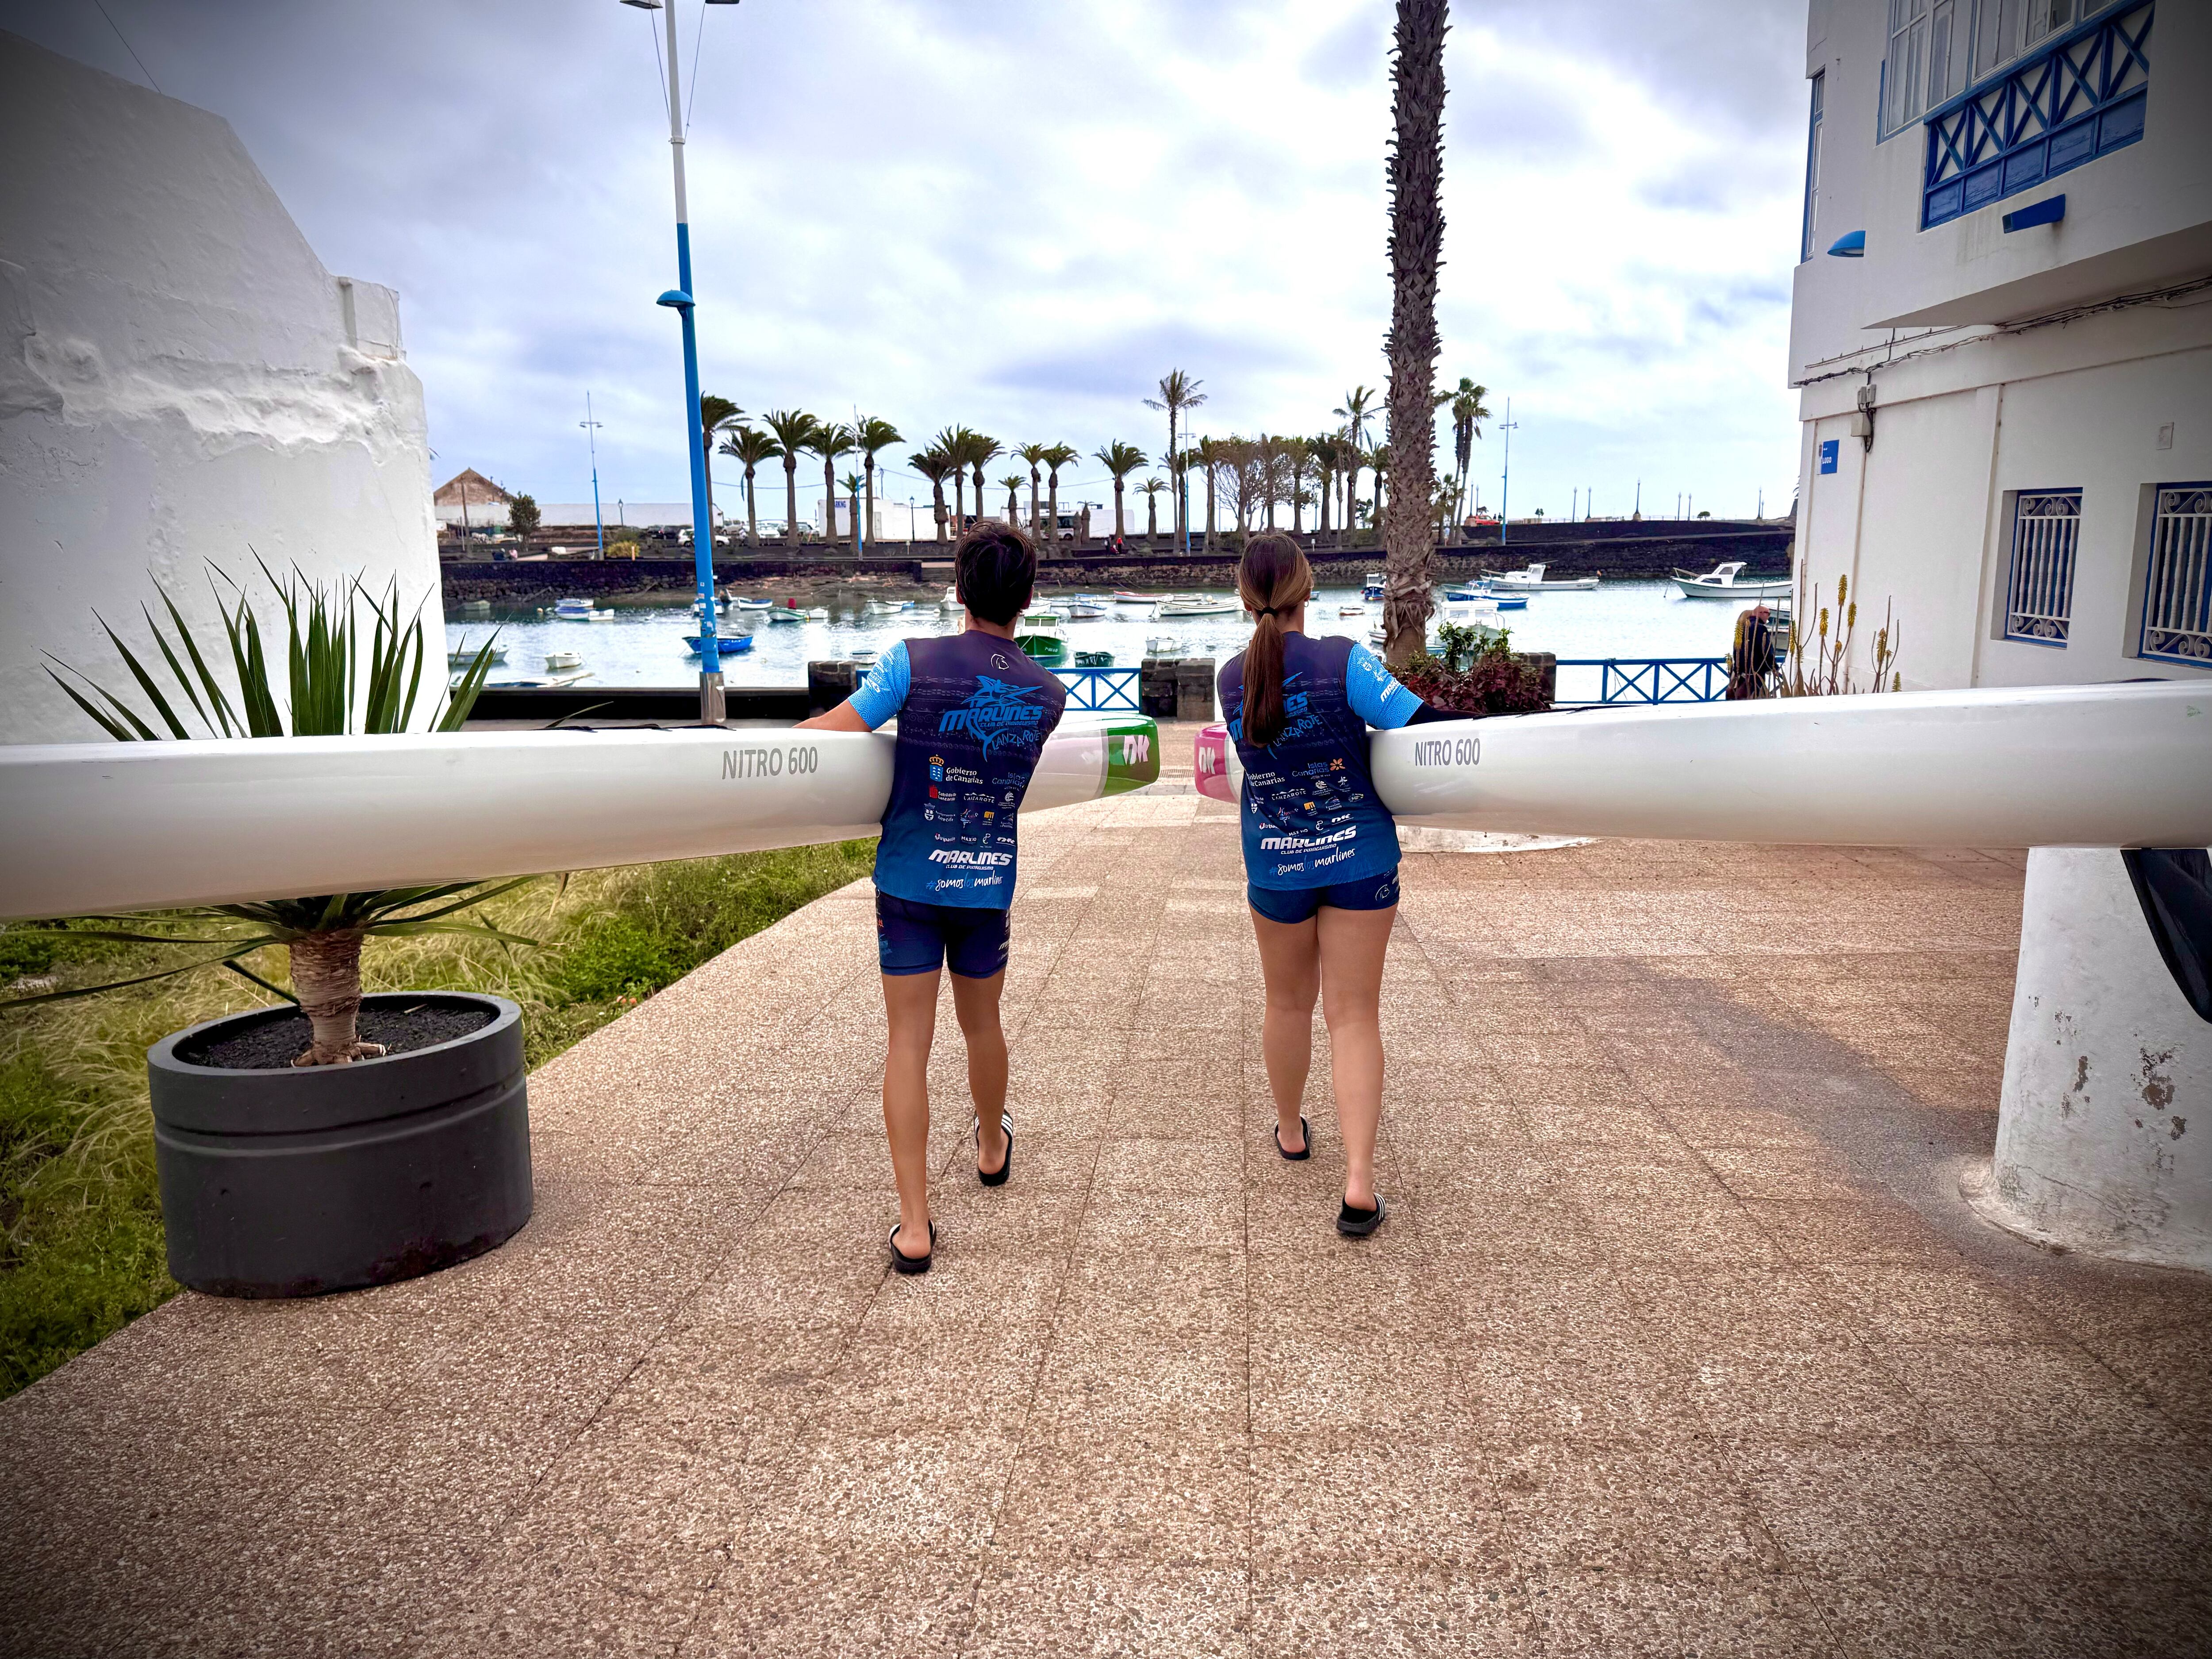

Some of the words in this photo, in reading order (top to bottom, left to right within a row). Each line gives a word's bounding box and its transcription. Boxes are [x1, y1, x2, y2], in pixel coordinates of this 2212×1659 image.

[938, 706, 1044, 732] MARLINES
[992, 730, 1041, 750] LANZAROTE
[1415, 739, 1452, 766] NITRO
[1455, 738, 1480, 765] 600
[722, 748, 783, 780] NITRO
[788, 746, 818, 775] 600
[946, 767, 977, 776] Gobierno
[1292, 767, 1329, 777] Canarias
[953, 774, 983, 784] Canarias
[1254, 777, 1285, 787] Canarias
[1261, 825, 1356, 849] MARLINES
[928, 849, 1013, 866] MARLINES
